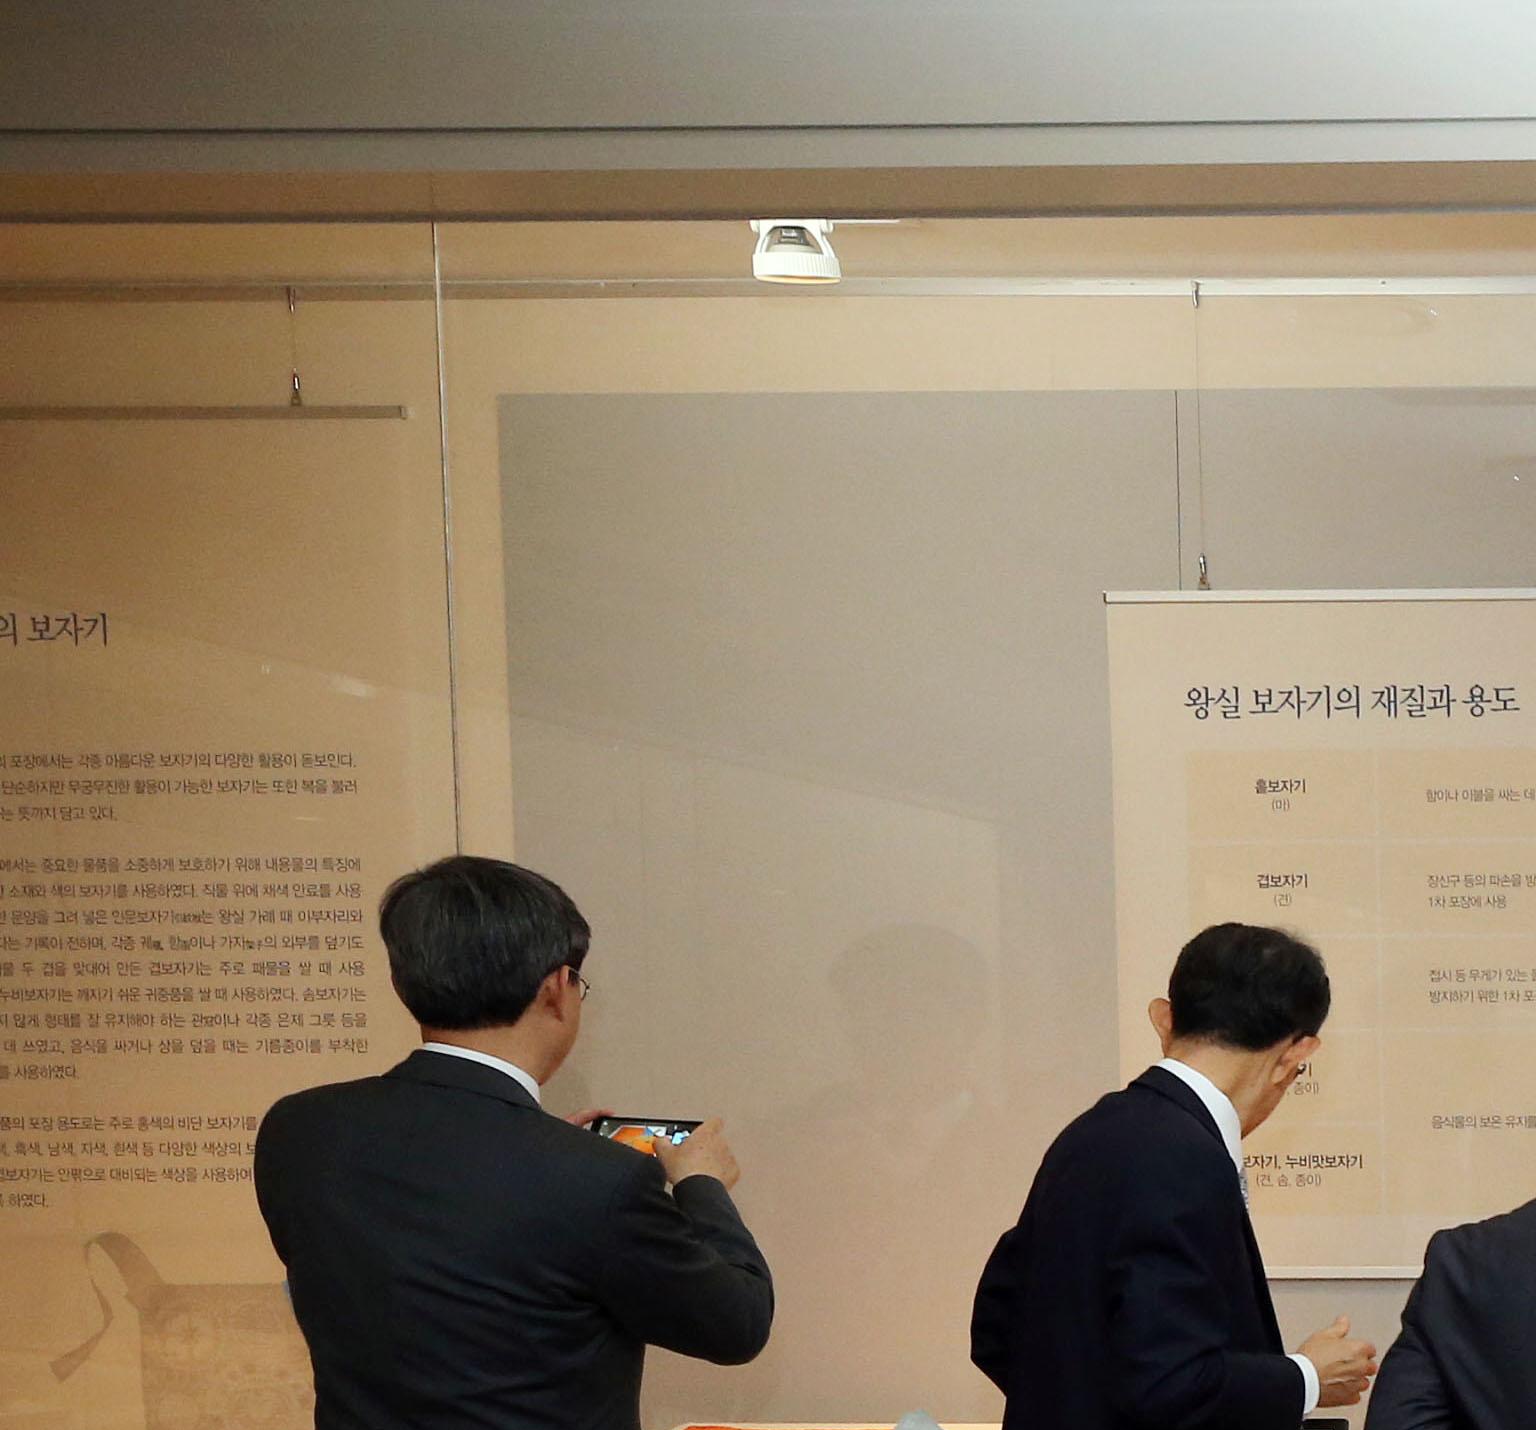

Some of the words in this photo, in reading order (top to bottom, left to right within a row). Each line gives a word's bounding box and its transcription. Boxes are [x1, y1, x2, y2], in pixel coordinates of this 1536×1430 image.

[0, 613, 17, 645] 의
[27, 613, 107, 646] 보자기
[1184, 687, 1240, 719] 왕실
[1249, 685, 1359, 718] 보자기의
[1372, 685, 1456, 717] 재질과
[1462, 684, 1520, 717] 용도
[11, 754, 72, 769] 포장에서는
[78, 754, 101, 769] 각종
[106, 753, 154, 768] 아름다운
[160, 754, 210, 767] 보자기의
[215, 753, 253, 768] 다양한
[2, 780, 64, 795] 단순하지만
[69, 780, 130, 795] 무궁무진한
[175, 779, 212, 794] 가능한
[216, 780, 268, 794] 보자기는
[273, 780, 297, 794] 또한
[59, 806, 84, 821] 담고
[89, 806, 117, 820] 있다.
[41, 859, 78, 873] 중요한
[124, 858, 174, 872] 소중하게
[179, 858, 230, 872] 보호하기
[235, 858, 260, 872] 위해
[266, 857, 317, 872] 내용물의
[323, 858, 360, 872] 특징에
[1258, 874, 1307, 888] 겹보자기
[1428, 875, 1460, 888] 장신구
[1464, 875, 1486, 888] 등의
[80, 884, 128, 898] 보자기를
[133, 883, 194, 898] 사용하였다.
[233, 884, 258, 897] 위에
[336, 883, 361, 898] 사용
[1486, 896, 1506, 908] 사용
[11, 910, 48, 925] 문양을
[55, 912, 77, 923] 그려
[219, 909, 244, 924] 왕실
[280, 911, 292, 922] 때
[298, 910, 362, 923] 이부자리와
[282, 936, 319, 949] 외부를
[325, 936, 364, 950] 덮기도
[73, 962, 110, 976] 맞대어
[117, 962, 141, 976] 만든
[149, 962, 211, 976] 겹보자기는
[220, 962, 245, 975] 주로
[299, 961, 311, 976] 쌀
[319, 962, 331, 975] 때
[339, 961, 365, 976] 사용
[1506, 969, 1528, 982] 있는
[78, 988, 112, 1001] 깨지기
[118, 987, 140, 1002] 쉬운
[145, 987, 193, 1002] 귀중품을
[199, 988, 211, 1002] 쌀
[215, 988, 227, 1000] 때
[232, 987, 298, 1002] 사용하였다.
[303, 987, 366, 1001] 솜보자기는
[1430, 990, 1473, 1003] 방지하기
[1478, 990, 1499, 1002] 위한
[13, 1014, 39, 1028] 않게
[45, 1014, 80, 1028] 형태를
[104, 1013, 154, 1027] 유지해야
[161, 1013, 185, 1027] 하는
[246, 1013, 271, 1028] 각종
[278, 1013, 303, 1027] 은제
[310, 1013, 336, 1027] 그릇
[341, 1013, 367, 1027] 등을
[71, 1039, 107, 1054] 음식을
[114, 1040, 152, 1053] 싸거나
[159, 1039, 184, 1054] 상을
[223, 1040, 248, 1053] 때는
[256, 1039, 320, 1053] 기름종이를
[329, 1039, 368, 1053] 부착한
[14, 1065, 76, 1080] 사용하였다.
[58, 1117, 104, 1131] 용도로는
[110, 1117, 133, 1129] 주로
[178, 1117, 202, 1130] 비단
[208, 1117, 259, 1130] 보자기를
[1432, 1116, 1476, 1129] 음식물의
[1480, 1116, 1502, 1128] 보온
[143, 1142, 153, 1157] 등
[160, 1142, 196, 1156] 다양한
[202, 1142, 241, 1156] 색상의
[58, 1168, 105, 1182] 안팎으로
[110, 1168, 156, 1182] 대비되는
[162, 1167, 197, 1182] 색상을
[9, 1194, 48, 1208] 하였다.
